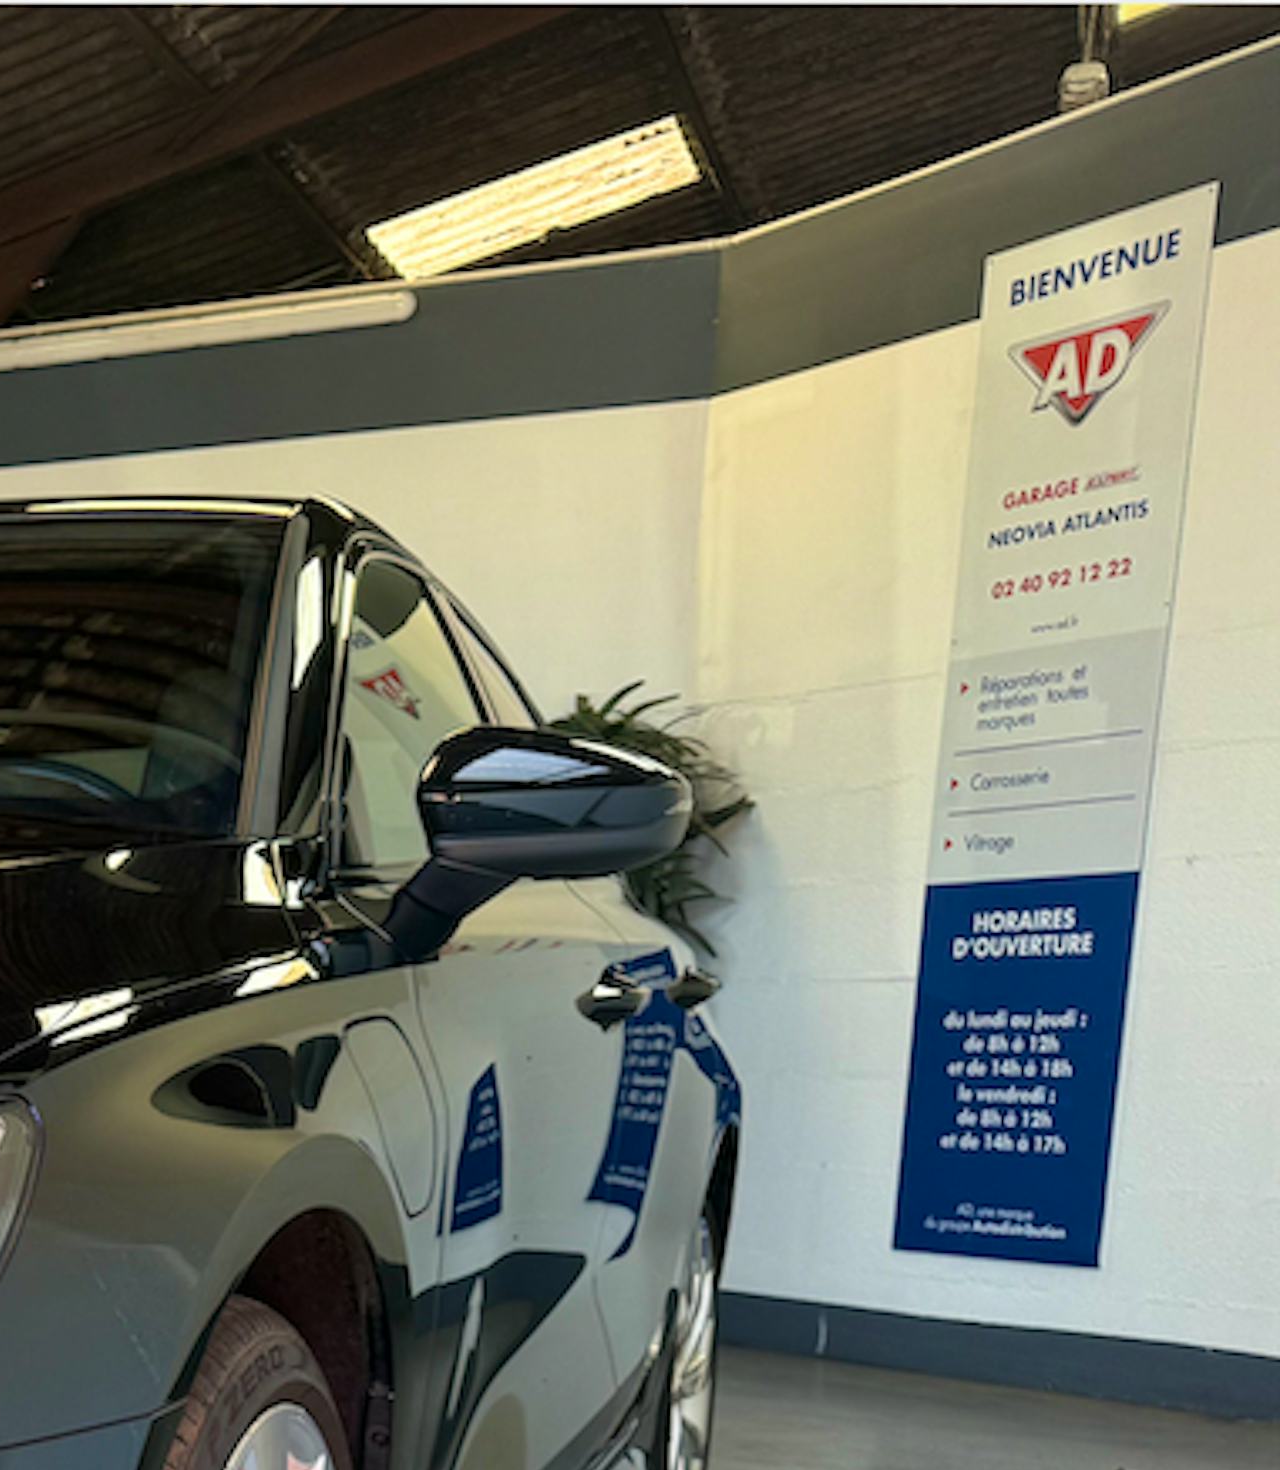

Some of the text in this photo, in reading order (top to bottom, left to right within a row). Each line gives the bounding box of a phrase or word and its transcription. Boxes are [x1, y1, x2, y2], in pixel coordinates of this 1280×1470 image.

[1010, 228, 1181, 308] BIENVENUE
[1036, 328, 1132, 408] AD
[1002, 477, 1080, 510] GARAGE
[987, 498, 1150, 549] NEOVIA ATLANTIS
[990, 556, 1133, 600] 02 40 92 12 22
[1071, 664, 1088, 682] et
[976, 685, 1090, 714] entretien toutes
[975, 712, 1036, 733] marques
[969, 766, 1051, 792] Carrosserie
[963, 833, 1015, 855] Vitrage
[971, 906, 1078, 934] HORAIRES
[951, 930, 1095, 961] D'OUVERTURE
[942, 1009, 966, 1030] du
[966, 1008, 1009, 1030] lundi
[1009, 1013, 1033, 1029] au
[1033, 1007, 1078, 1033] jeudi
[962, 1033, 1061, 1054] de 8h à 12h
[945, 1057, 1074, 1078] et de 14h à 18h
[956, 1081, 973, 1103] le
[975, 1084, 1047, 1105] vendredi
[955, 1106, 1053, 1128] de 8h à 12h
[939, 1130, 1067, 1154] et de 14h à 17h
